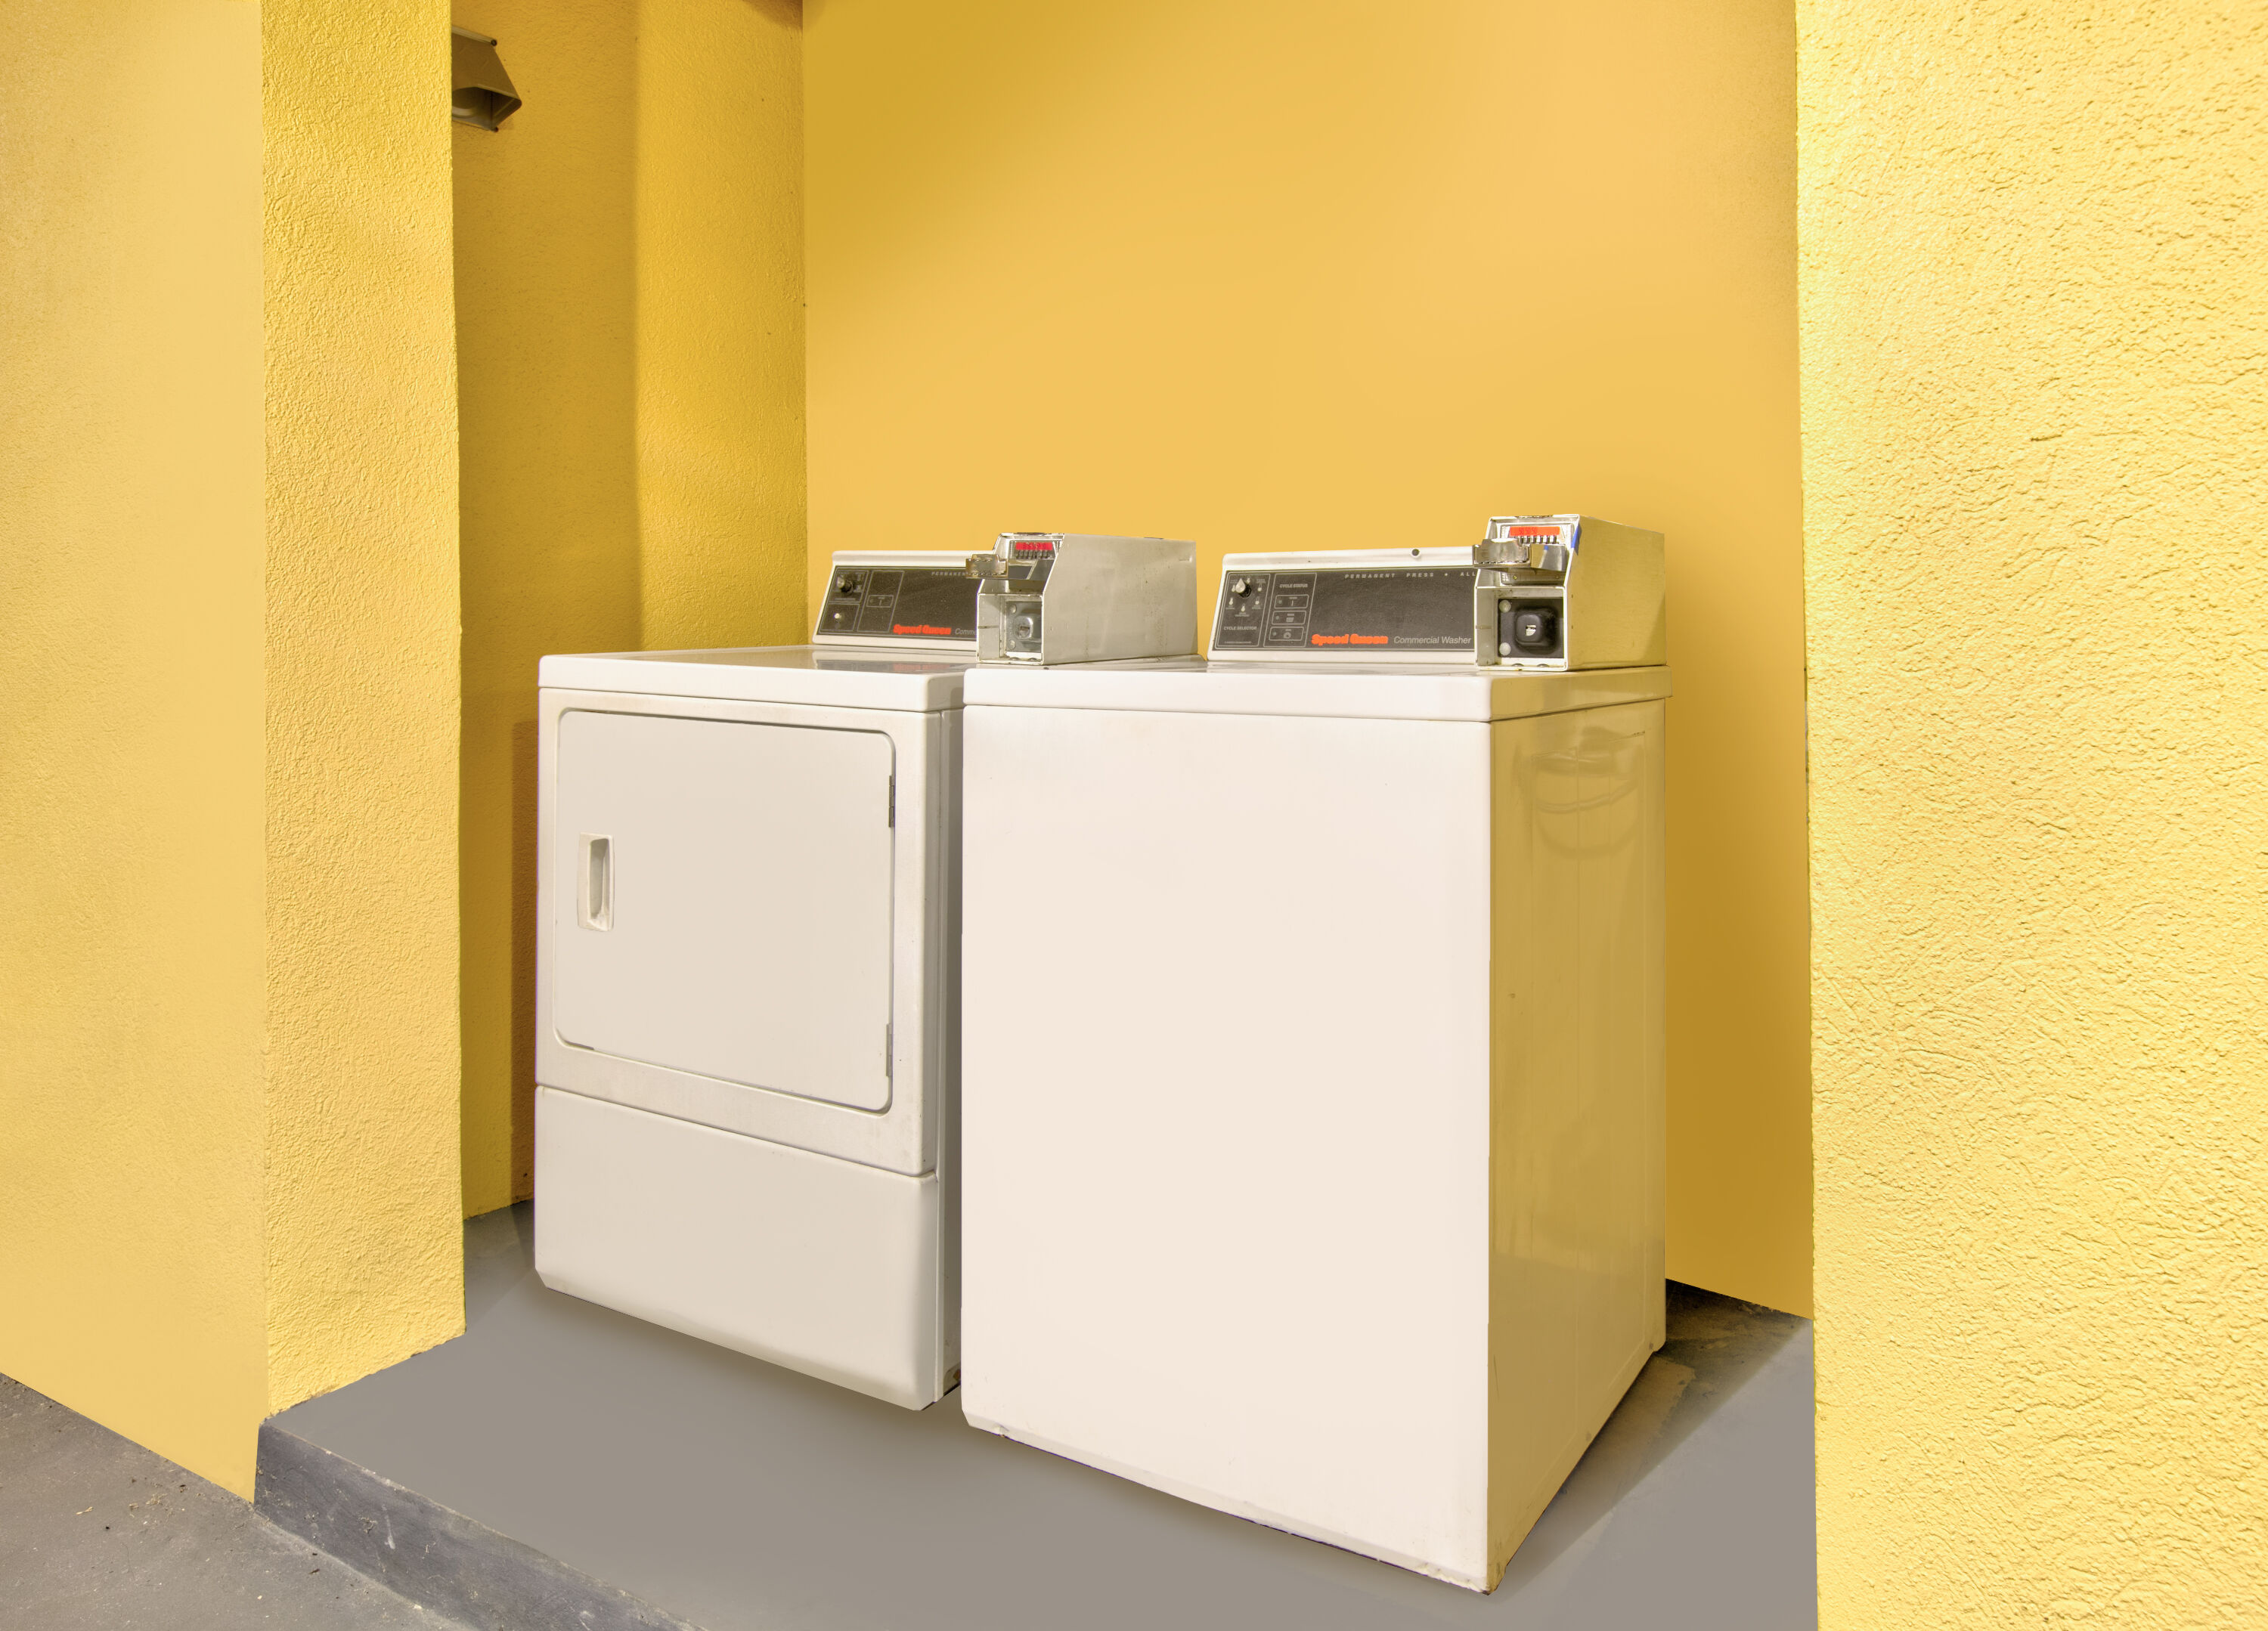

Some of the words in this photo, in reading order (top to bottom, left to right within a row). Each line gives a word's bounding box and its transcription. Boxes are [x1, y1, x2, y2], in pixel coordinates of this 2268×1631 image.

[893, 624, 922, 635] Speed
[922, 624, 951, 635] Queen
[1311, 633, 1349, 645] Speed
[1349, 633, 1389, 645] Queen
[1393, 636, 1439, 644] Commercial
[1440, 636, 1471, 644] Washer
